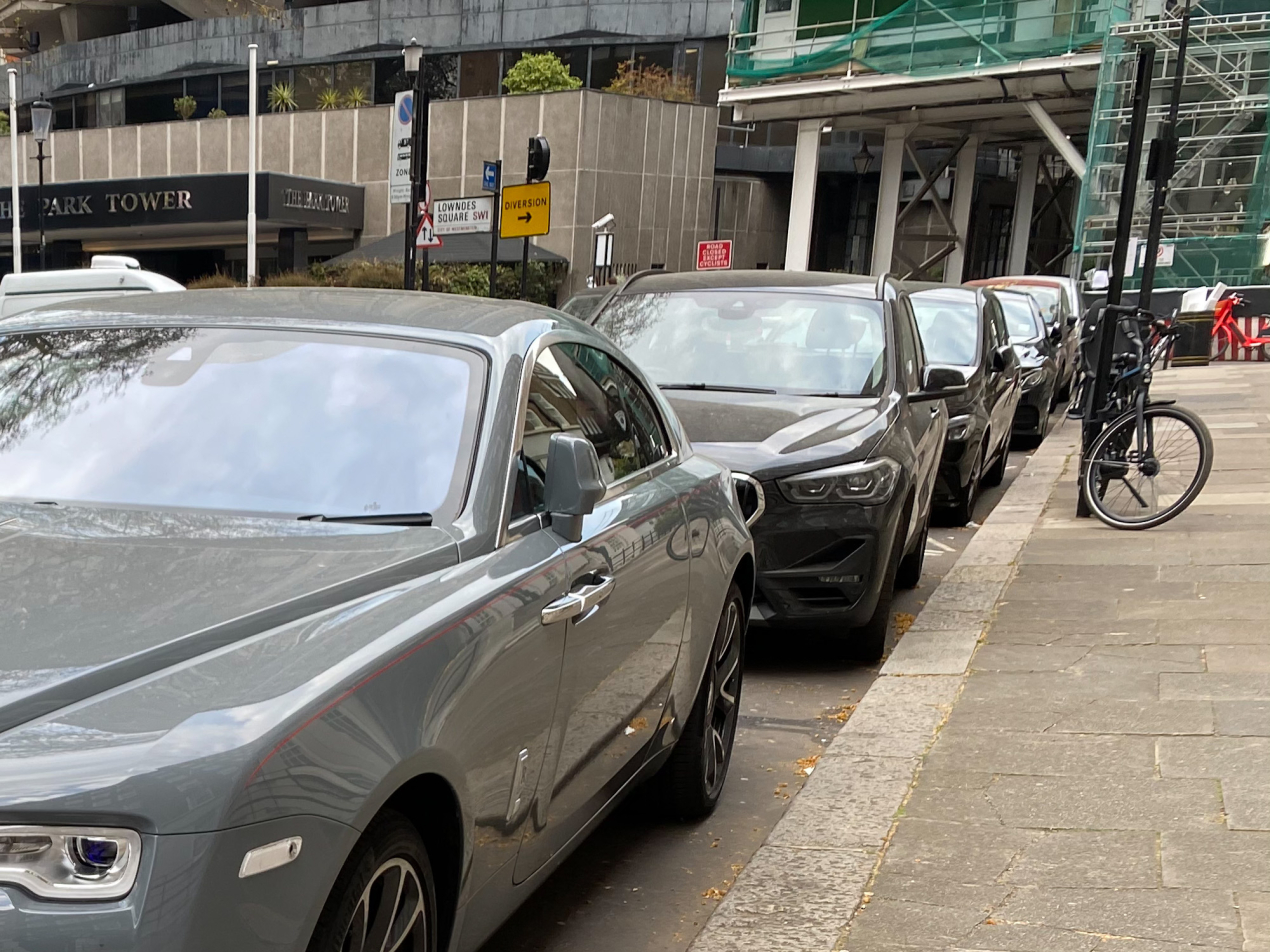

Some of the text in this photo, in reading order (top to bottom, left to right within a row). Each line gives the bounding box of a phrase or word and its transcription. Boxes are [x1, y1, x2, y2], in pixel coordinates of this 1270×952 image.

[396, 168, 410, 176] ZON
[38, 195, 92, 216] PARK
[106, 190, 193, 213] TOWER
[438, 201, 476, 212] LOWNDES
[505, 198, 547, 210] DIVERSION
[438, 210, 489, 223] SQUARE SW1
